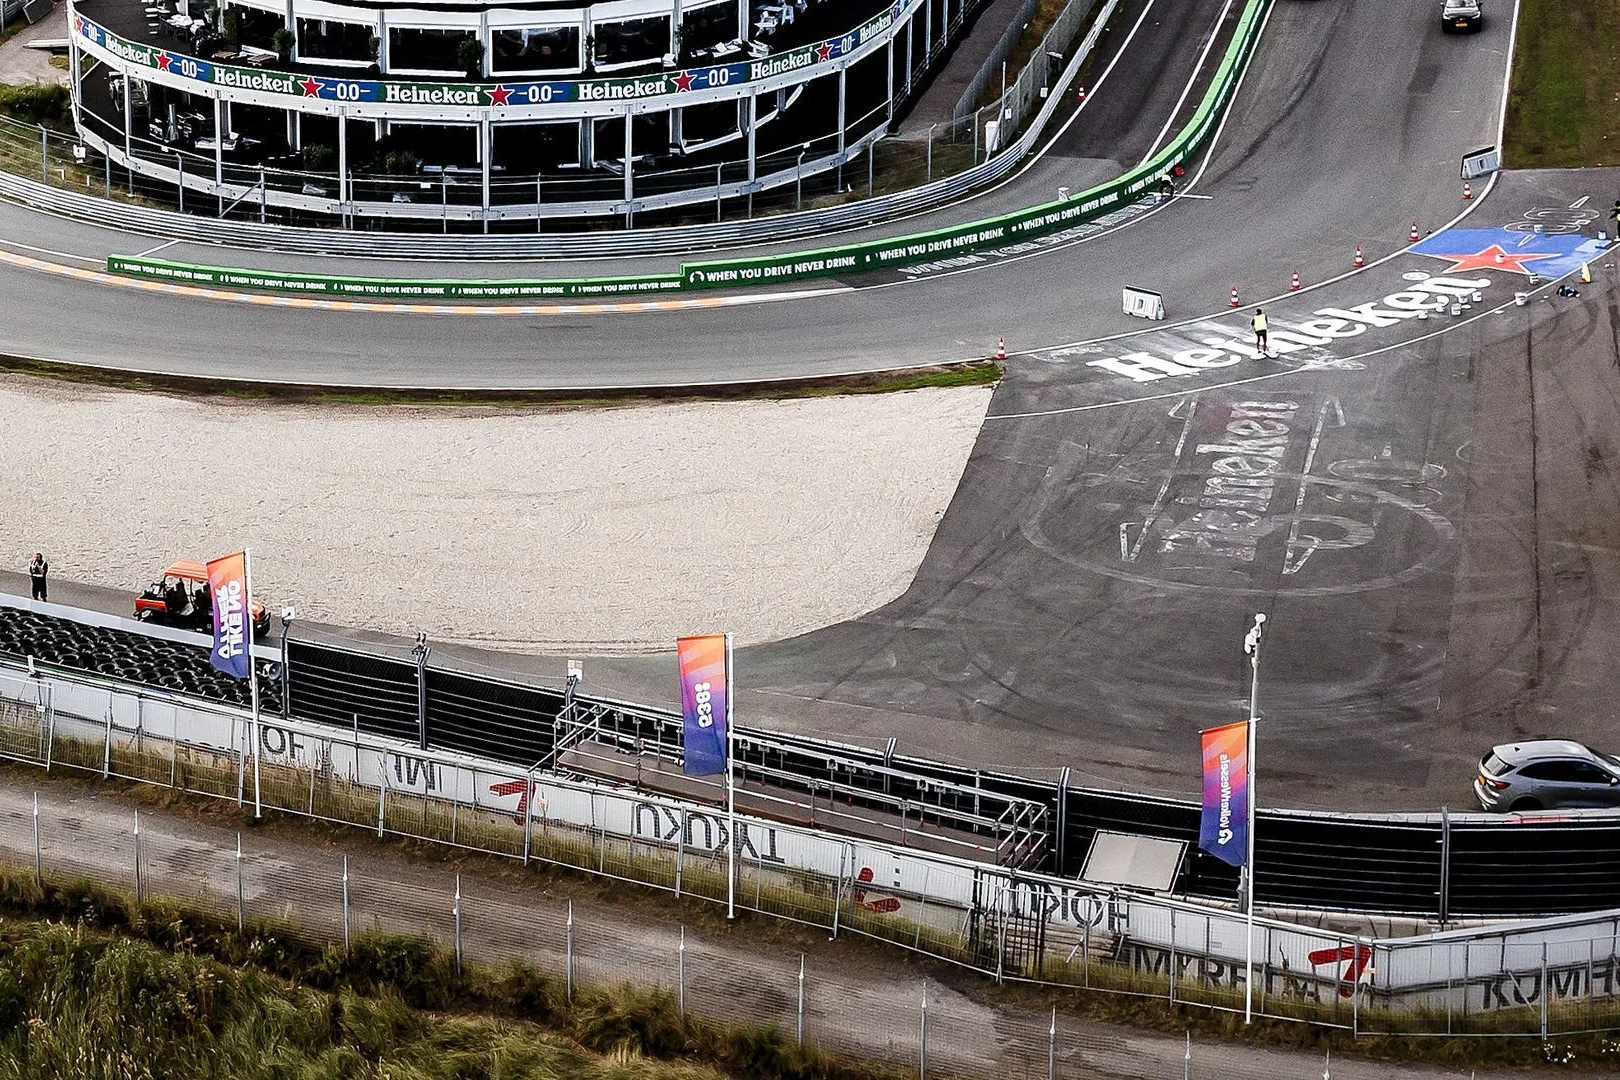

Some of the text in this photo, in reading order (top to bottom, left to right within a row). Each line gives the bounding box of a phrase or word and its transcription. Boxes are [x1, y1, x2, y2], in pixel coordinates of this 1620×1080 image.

[105, 33, 151, 66] Heineken
[214, 69, 294, 93] Heineken
[385, 85, 479, 105] Heineken
[578, 79, 666, 101] Heineken
[750, 50, 812, 80] Heineken
[860, 13, 892, 44] Heineken
[1023, 192, 1118, 231] WHEN YOU DRIVE NEVER DRINK
[880, 227, 1004, 261] WHEN YOU DRIVE NEVER DRINK
[707, 256, 856, 282] WHEN YOU DRIVE NEVER DRINK
[230, 276, 326, 290] WHEN YOU DRIVE NEVER DRINK
[401, 286, 422, 294] NEVER
[520, 286, 541, 294] NEVER
[582, 285, 602, 293] WHEN
[603, 284, 617, 292] YOU
[638, 282, 659, 290] NEVER
[660, 281, 681, 289] DRINK
[1086, 275, 1492, 383] Heineken
